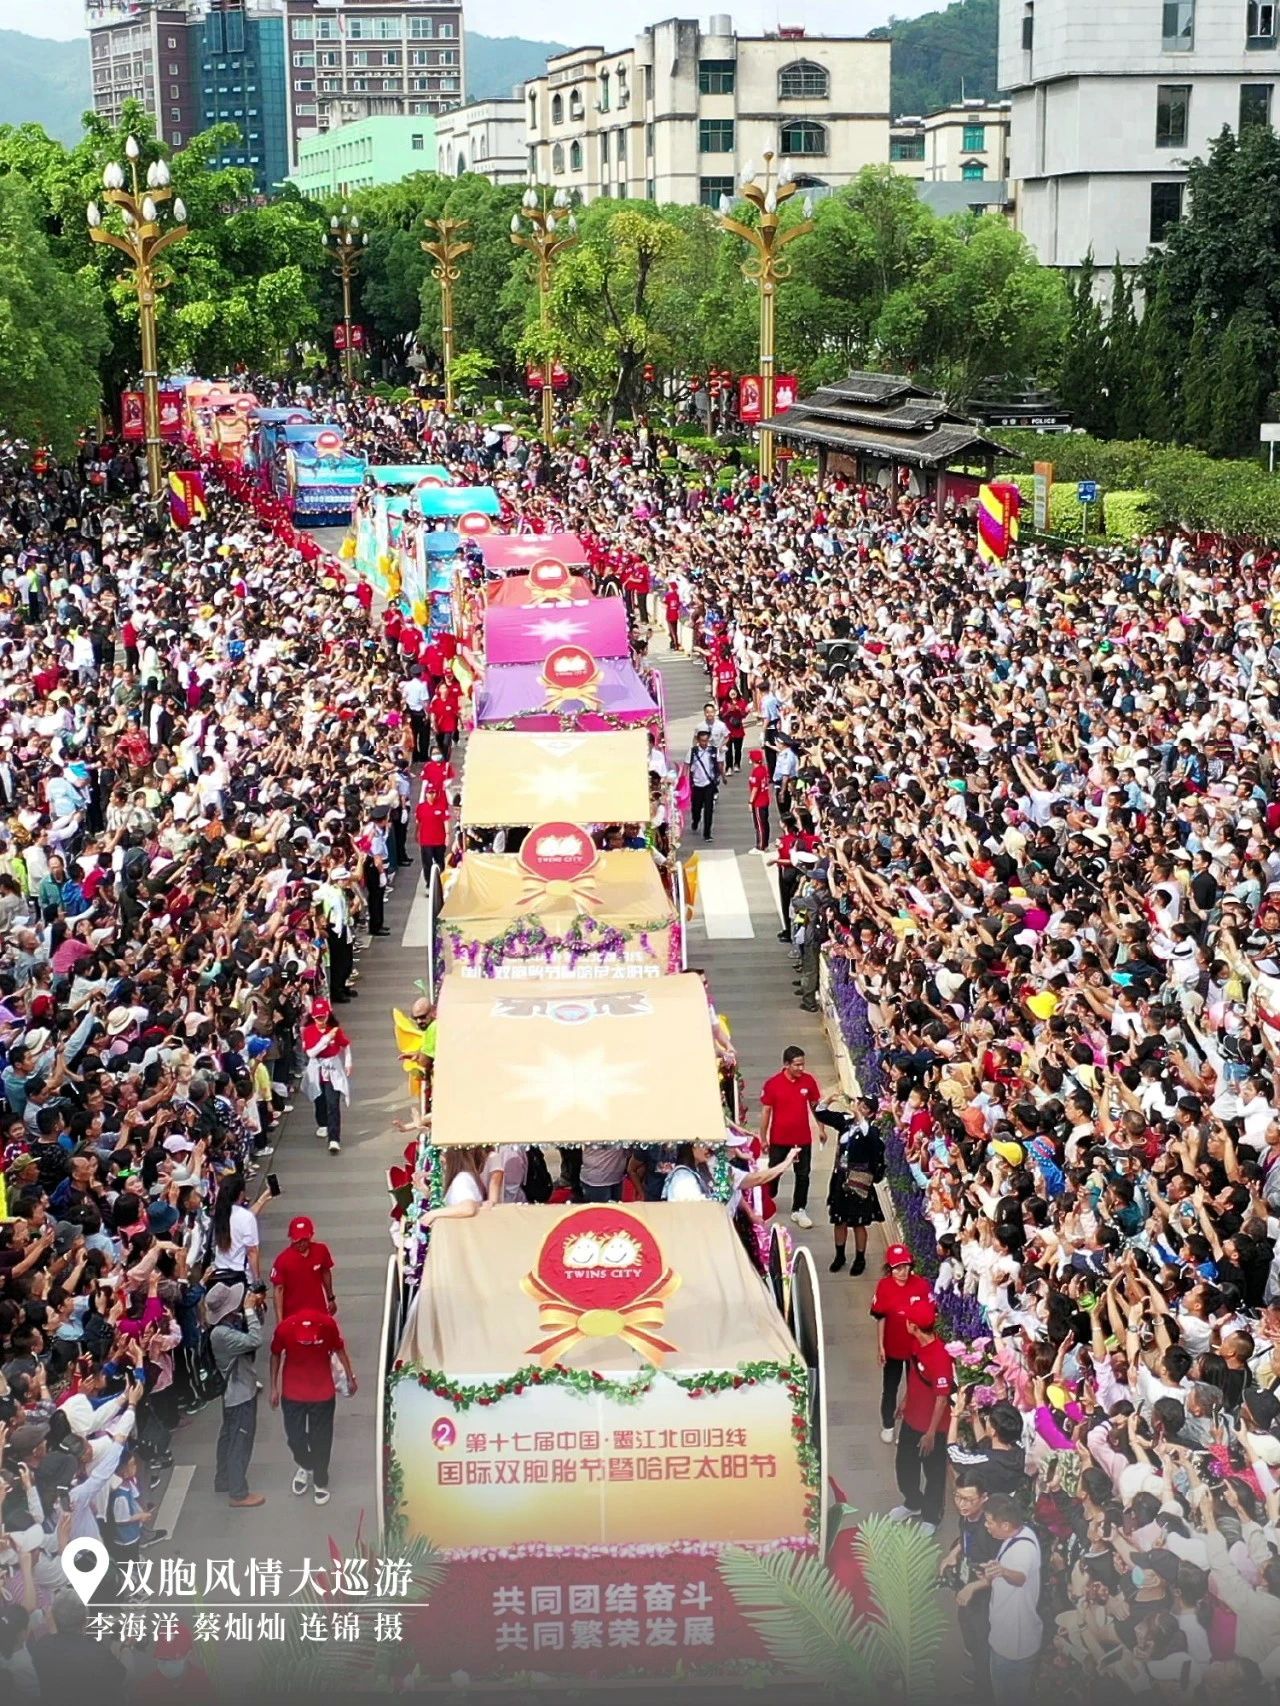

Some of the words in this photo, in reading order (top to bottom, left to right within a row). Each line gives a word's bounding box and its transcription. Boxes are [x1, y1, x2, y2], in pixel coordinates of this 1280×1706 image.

[1031, 417, 1056, 425] POLICE
[564, 1269, 607, 1280] TWINS
[610, 1268, 643, 1279] CITY
[437, 1453, 777, 1486] 国际双胞胎节暨哈尼太阳节
[492, 1580, 714, 1616] 共同团结奋斗
[495, 1615, 716, 1652] 共同繁荣发展
